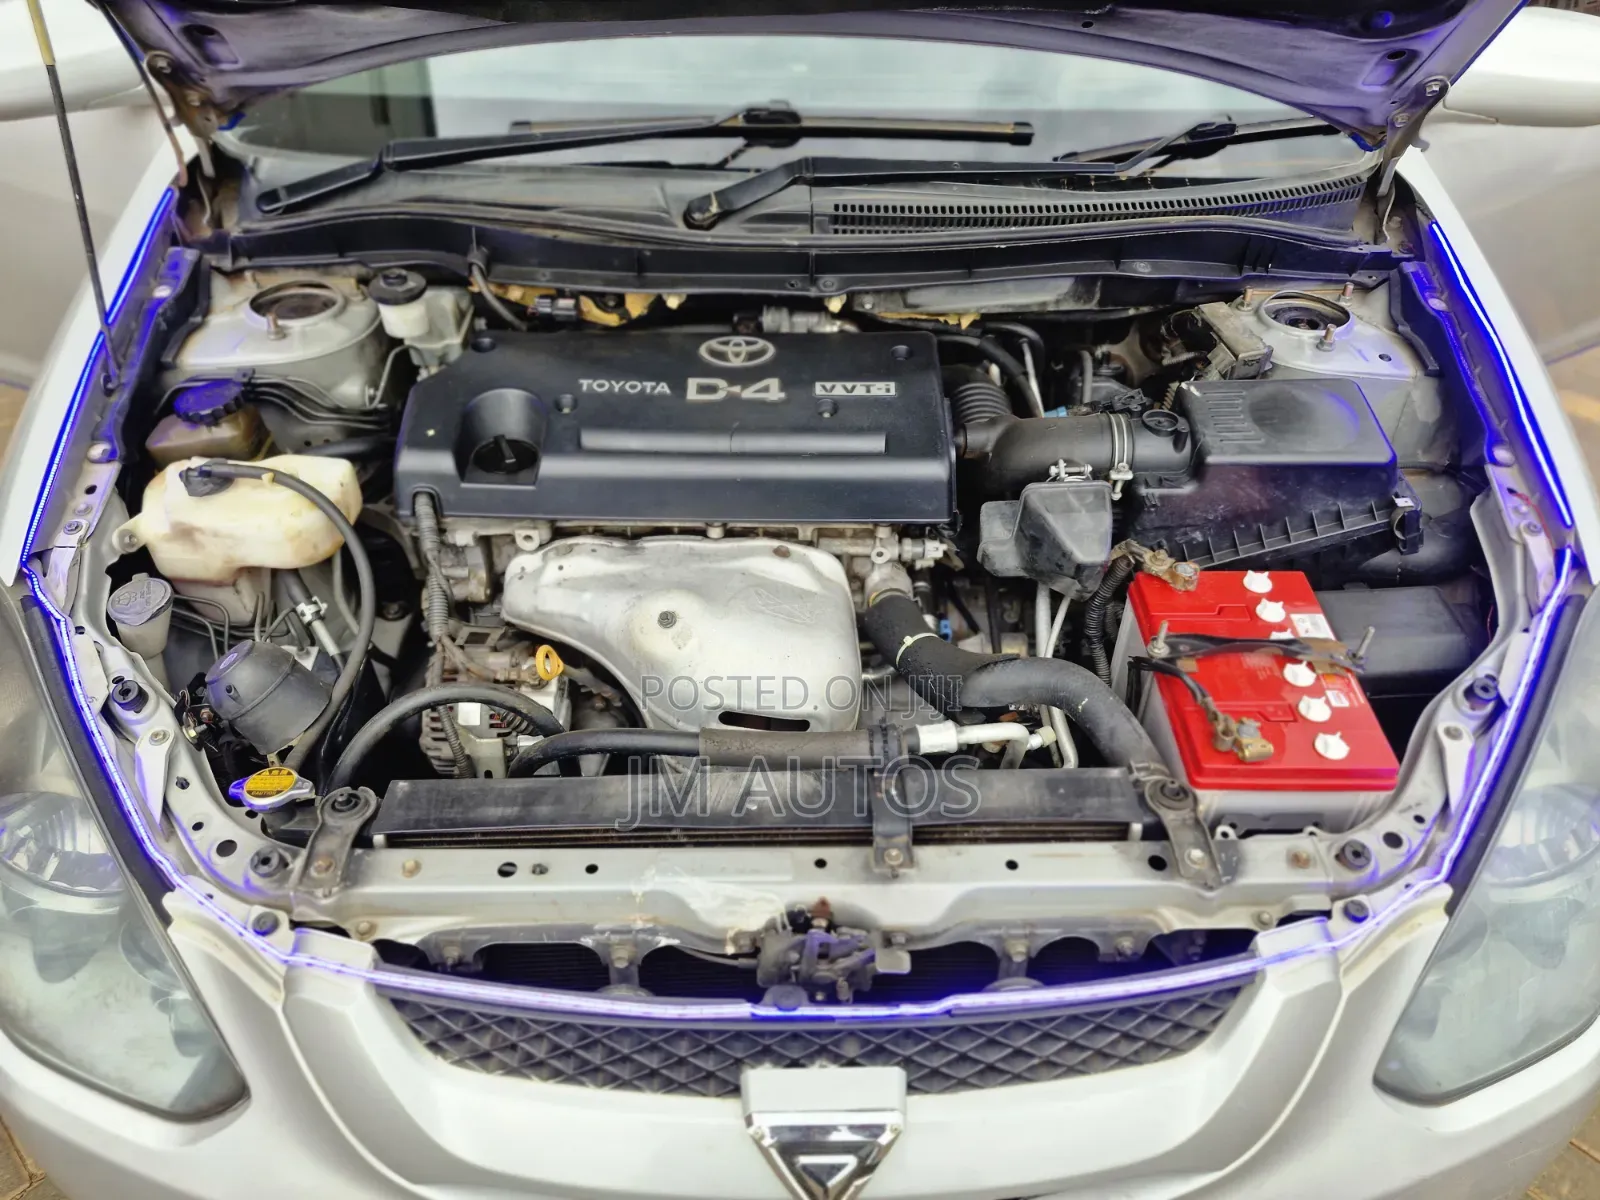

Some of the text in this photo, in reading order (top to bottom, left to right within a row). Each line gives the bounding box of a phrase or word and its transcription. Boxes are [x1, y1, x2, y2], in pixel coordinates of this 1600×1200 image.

[578, 378, 892, 401] TOYOTA D-4 VVT-i
